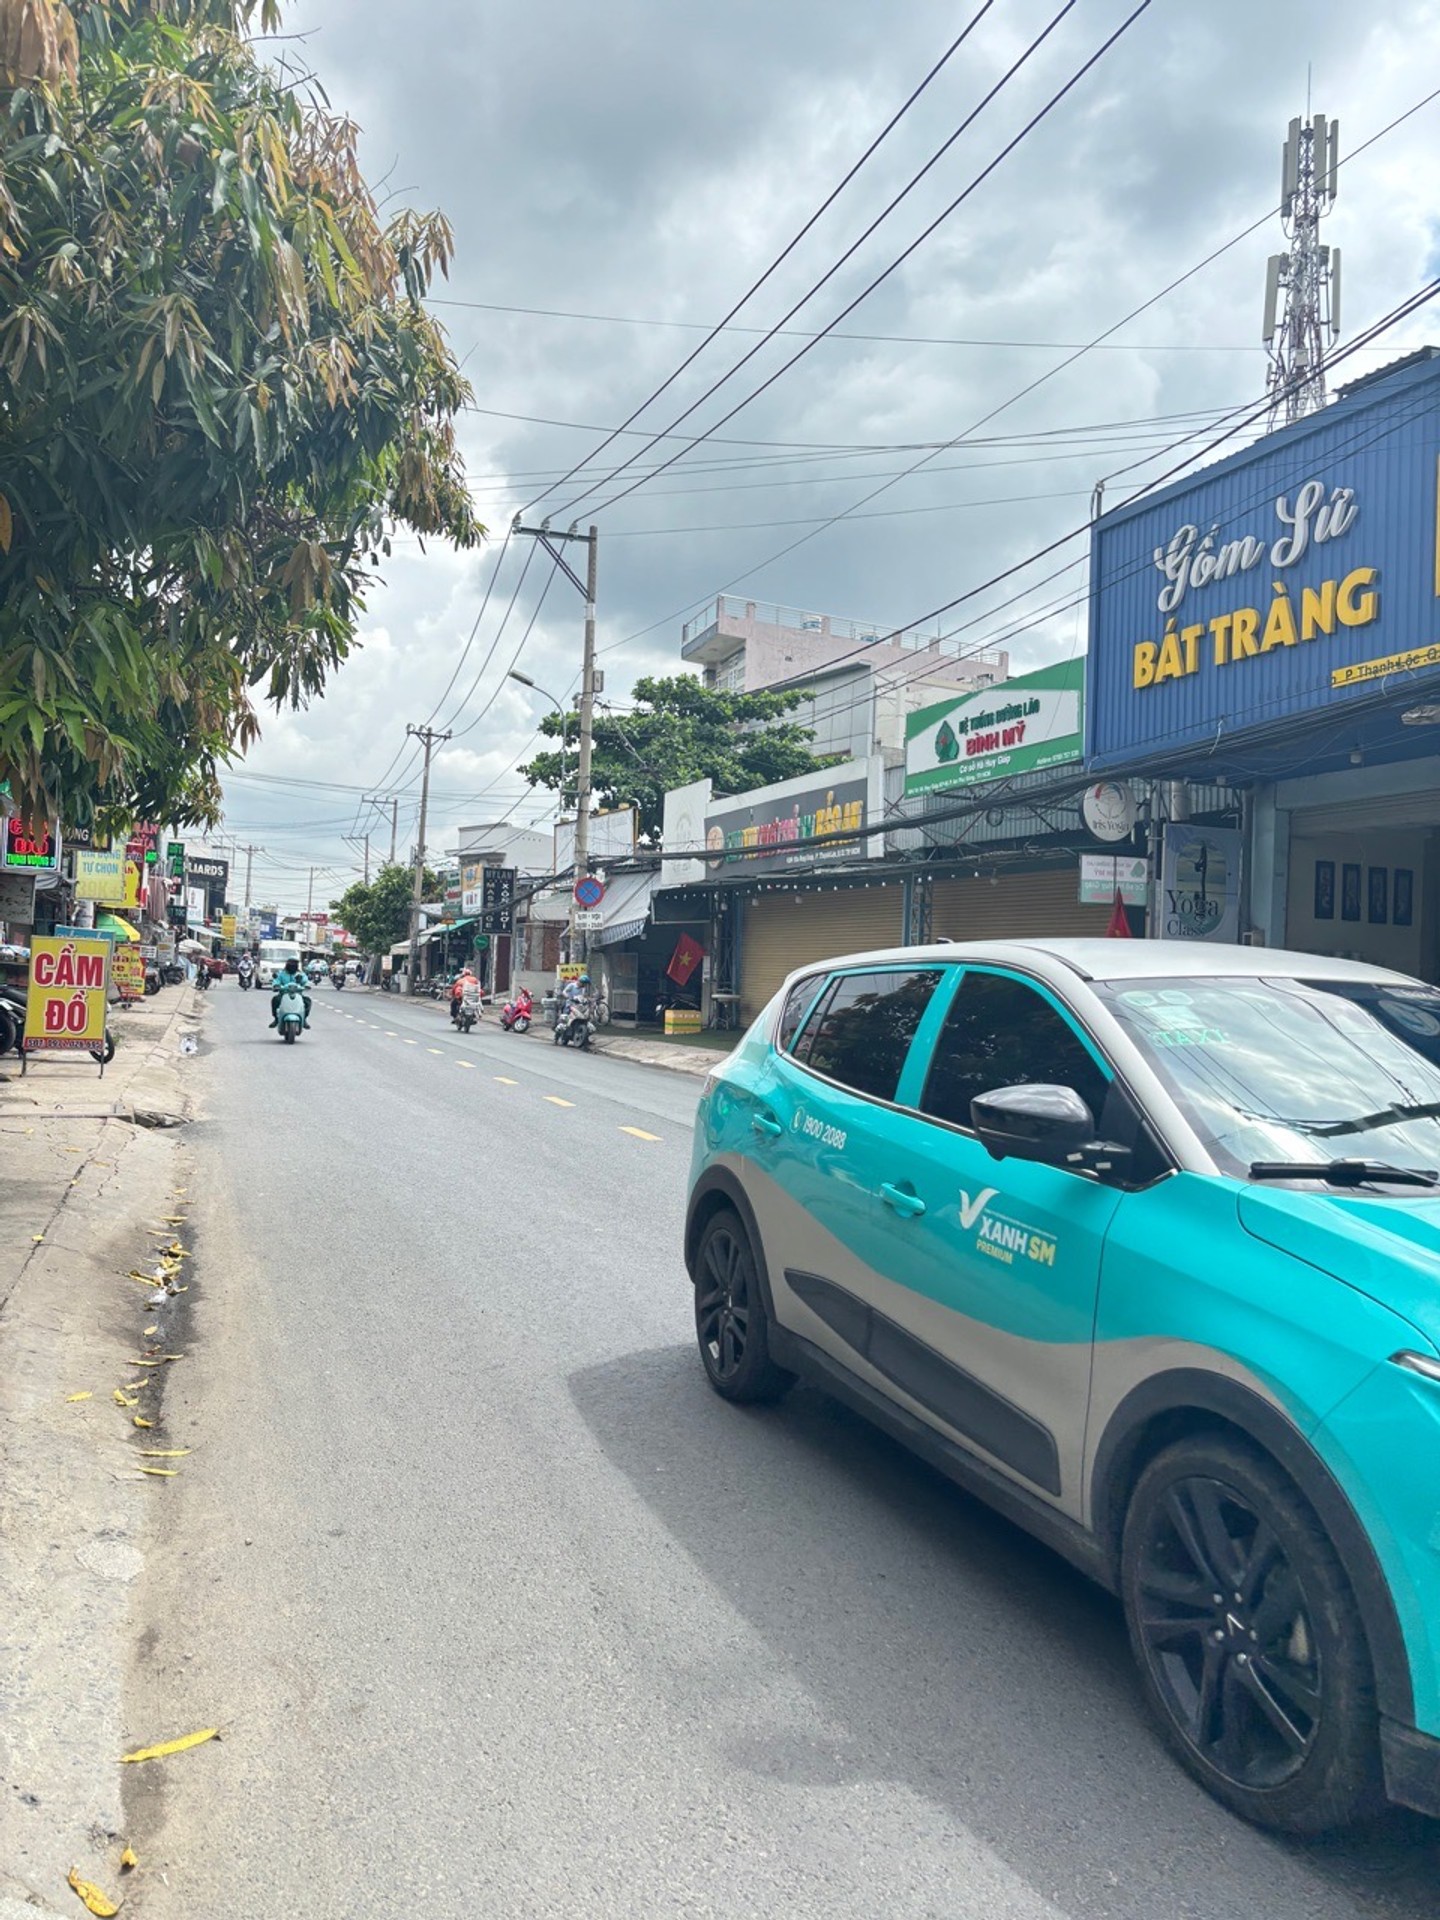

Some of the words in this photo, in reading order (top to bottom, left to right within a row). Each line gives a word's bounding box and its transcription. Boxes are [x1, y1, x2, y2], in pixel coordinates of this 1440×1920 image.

[1154, 524, 1266, 613] Gốm
[1133, 617, 1205, 690] BÁT
[1209, 566, 1378, 667] TRÀNG
[966, 732, 999, 757] BÌNH
[1002, 720, 1025, 747] MỸ
[1107, 821, 1130, 834] Yoga
[82, 861, 94, 875] TỰ
[1167, 890, 1218, 921] Yoga
[1167, 920, 1206, 937] Class
[34, 943, 104, 988] CẦM
[45, 990, 87, 1033] ĐỒ
[803, 1114, 824, 1139] 1900
[821, 1124, 847, 1150] 2088
[976, 1239, 1014, 1265] PREMIUM
[979, 1215, 1029, 1255] XANH
[1028, 1236, 1056, 1267] SM
